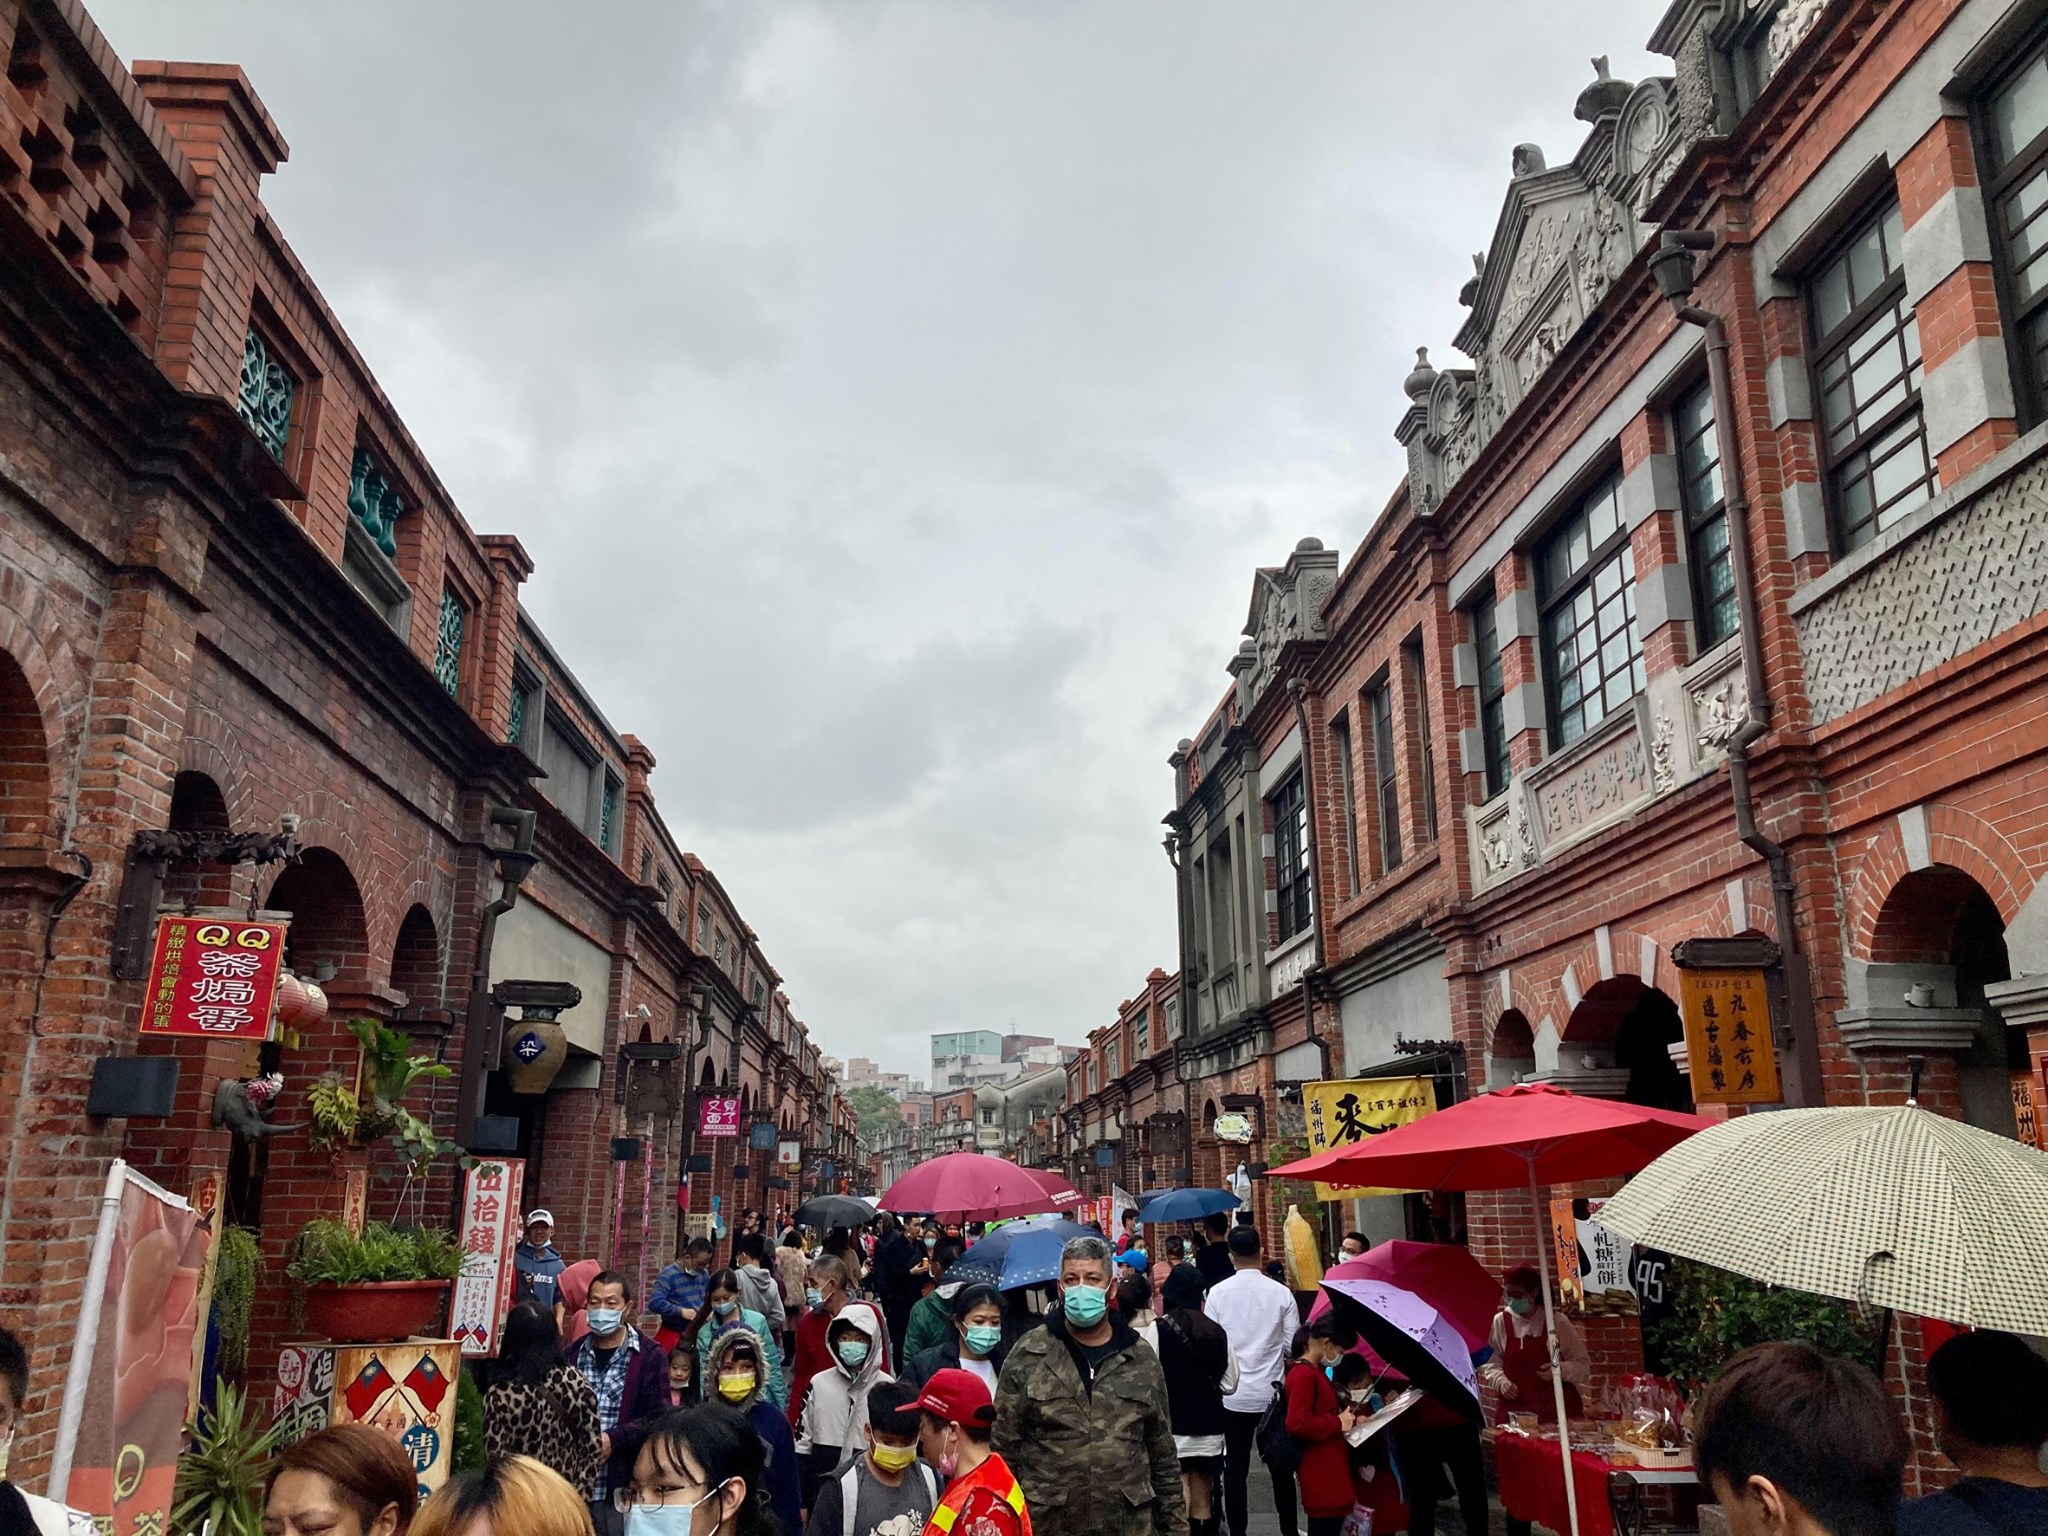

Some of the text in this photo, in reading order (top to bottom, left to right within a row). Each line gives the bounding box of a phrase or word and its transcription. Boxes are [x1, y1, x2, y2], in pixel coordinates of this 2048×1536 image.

[196, 925, 271, 950] QQ
[153, 924, 187, 1028] 精緻烘焙會動的蛋
[188, 951, 262, 1032] 茶焗蛋
[519, 1040, 539, 1057] 染
[113, 1443, 145, 1502] Q
[405, 1432, 435, 1468] 清
